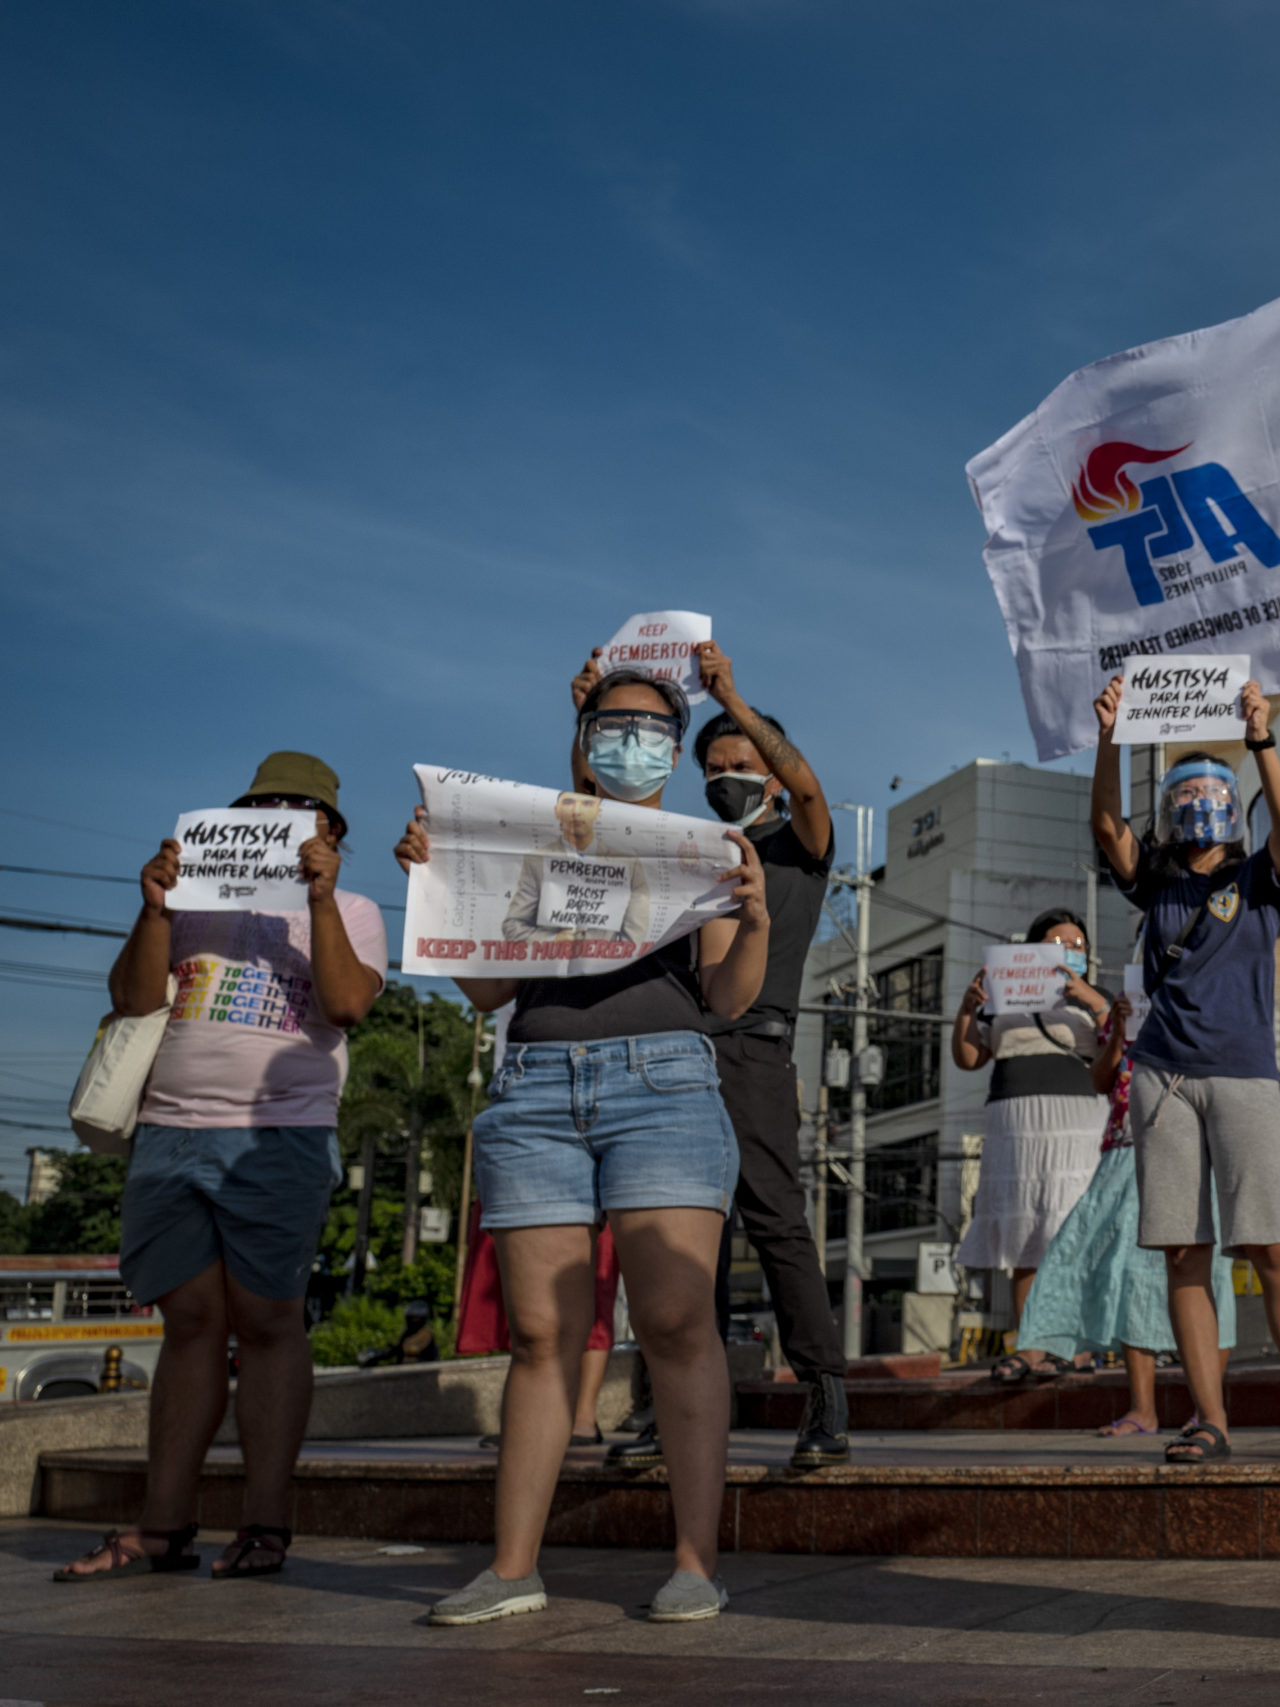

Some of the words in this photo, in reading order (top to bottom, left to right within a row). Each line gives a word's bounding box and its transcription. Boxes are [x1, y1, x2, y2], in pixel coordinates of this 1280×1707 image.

[638, 623, 668, 638] KEEP
[1131, 666, 1230, 691] HUSTISYA
[1149, 691, 1181, 704] PARA
[1184, 689, 1208, 702] KAY
[1127, 705, 1191, 721] JENNIFER
[1194, 703, 1235, 719] LAUDE
[183, 818, 292, 848] HUSTISYA
[202, 848, 237, 862] PARA
[242, 848, 267, 861] KAY
[179, 863, 249, 879] JENNIFER
[253, 864, 299, 881] LAUDE
[567, 884, 608, 900] FASCIST
[565, 898, 605, 912] RAPIST
[550, 910, 609, 926] MURDERER
[416, 937, 477, 960] KEEP
[481, 940, 528, 961] THIS
[531, 940, 636, 961] MURDERER
[224, 966, 312, 992] TOGETHER
[992, 967, 1057, 980] PEMBERTON
[218, 979, 310, 1008] TOGETHER
[213, 993, 307, 1020] TOGETHER
[208, 1008, 301, 1034] TOGETHER
